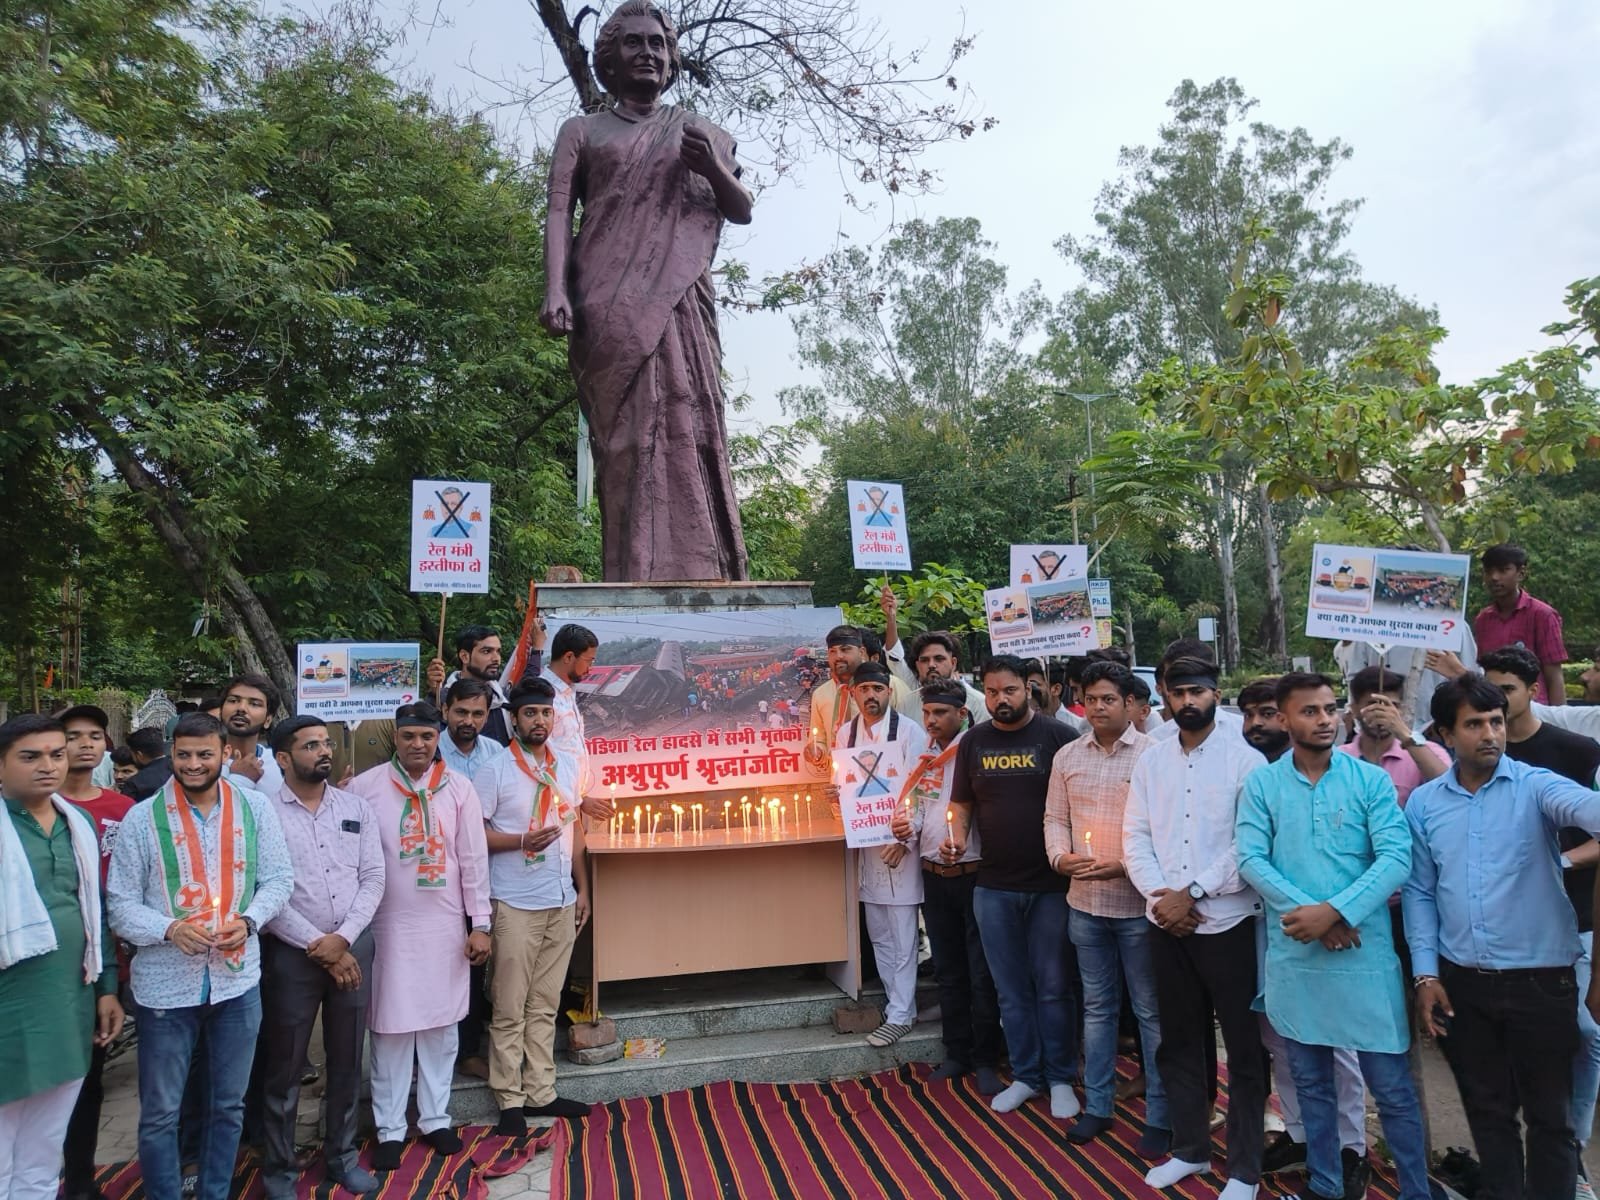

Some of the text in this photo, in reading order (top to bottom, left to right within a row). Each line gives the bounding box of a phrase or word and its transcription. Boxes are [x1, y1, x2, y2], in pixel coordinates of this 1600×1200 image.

[864, 530, 896, 542] रेल मंत्री
[428, 542, 473, 557] रेल मंत्री
[419, 558, 481, 574] इस्तीफा दो
[1317, 612, 1455, 635] क्या यही है आपका सुरक्षा कवच ?
[1081, 626, 1091, 638] ?
[365, 699, 383, 708] सुरक्षा
[630, 734, 657, 752] रेल
[662, 730, 702, 750] हादसे
[707, 729, 720, 746] में
[725, 728, 755, 745] सभी
[760, 724, 802, 747] मृतकों
[982, 754, 1036, 770] WORK
[602, 754, 689, 791] अश्रुपूर्ण
[856, 797, 895, 814] रेल मंत्री
[850, 814, 891, 831] इस्तीफा
